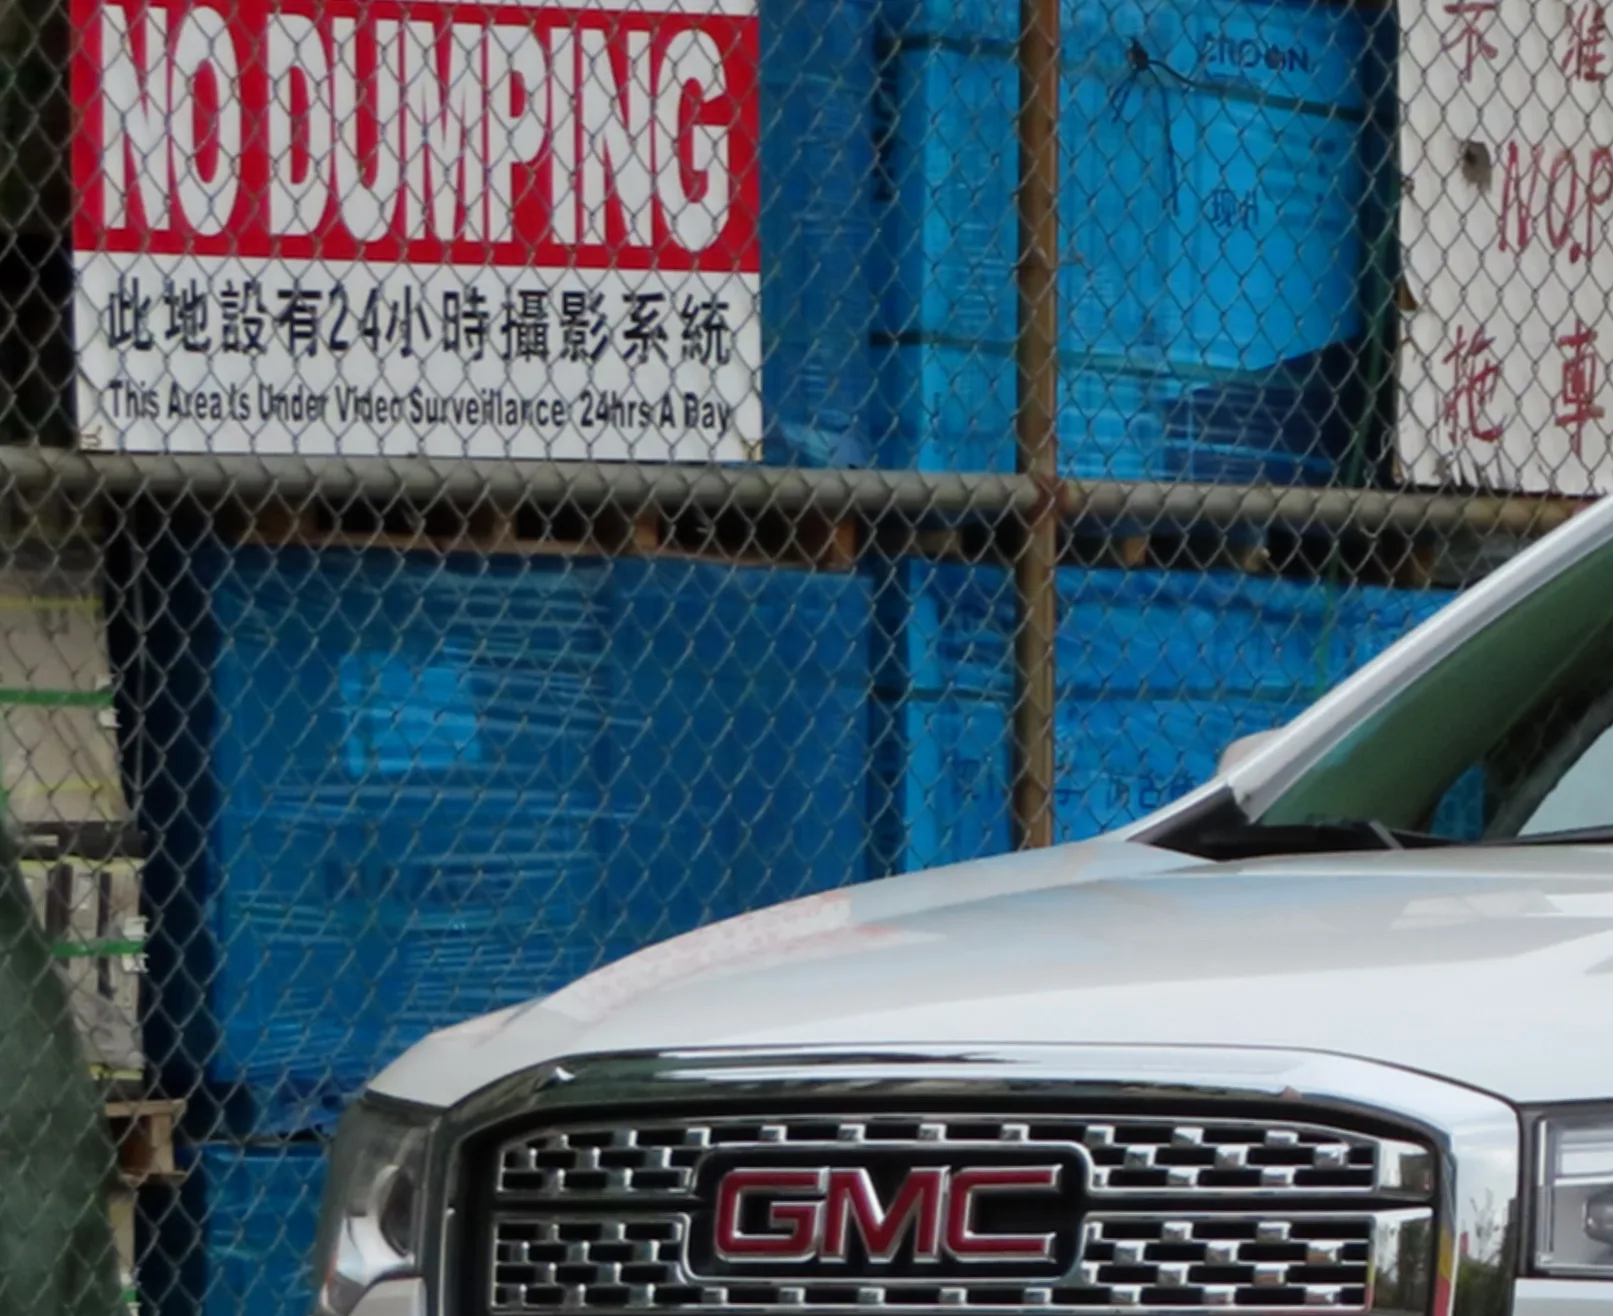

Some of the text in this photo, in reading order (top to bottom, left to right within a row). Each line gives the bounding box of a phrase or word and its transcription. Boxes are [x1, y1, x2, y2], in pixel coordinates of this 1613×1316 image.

[101, 4, 730, 252] NO DUMPING
[108, 380, 160, 419] This
[167, 381, 222, 421] Area
[258, 384, 327, 422] Under
[335, 385, 402, 424] Video
[409, 386, 566, 428] Surveillance
[659, 393, 676, 429] A
[684, 392, 730, 439] Day
[714, 1164, 1063, 1264] GMC
